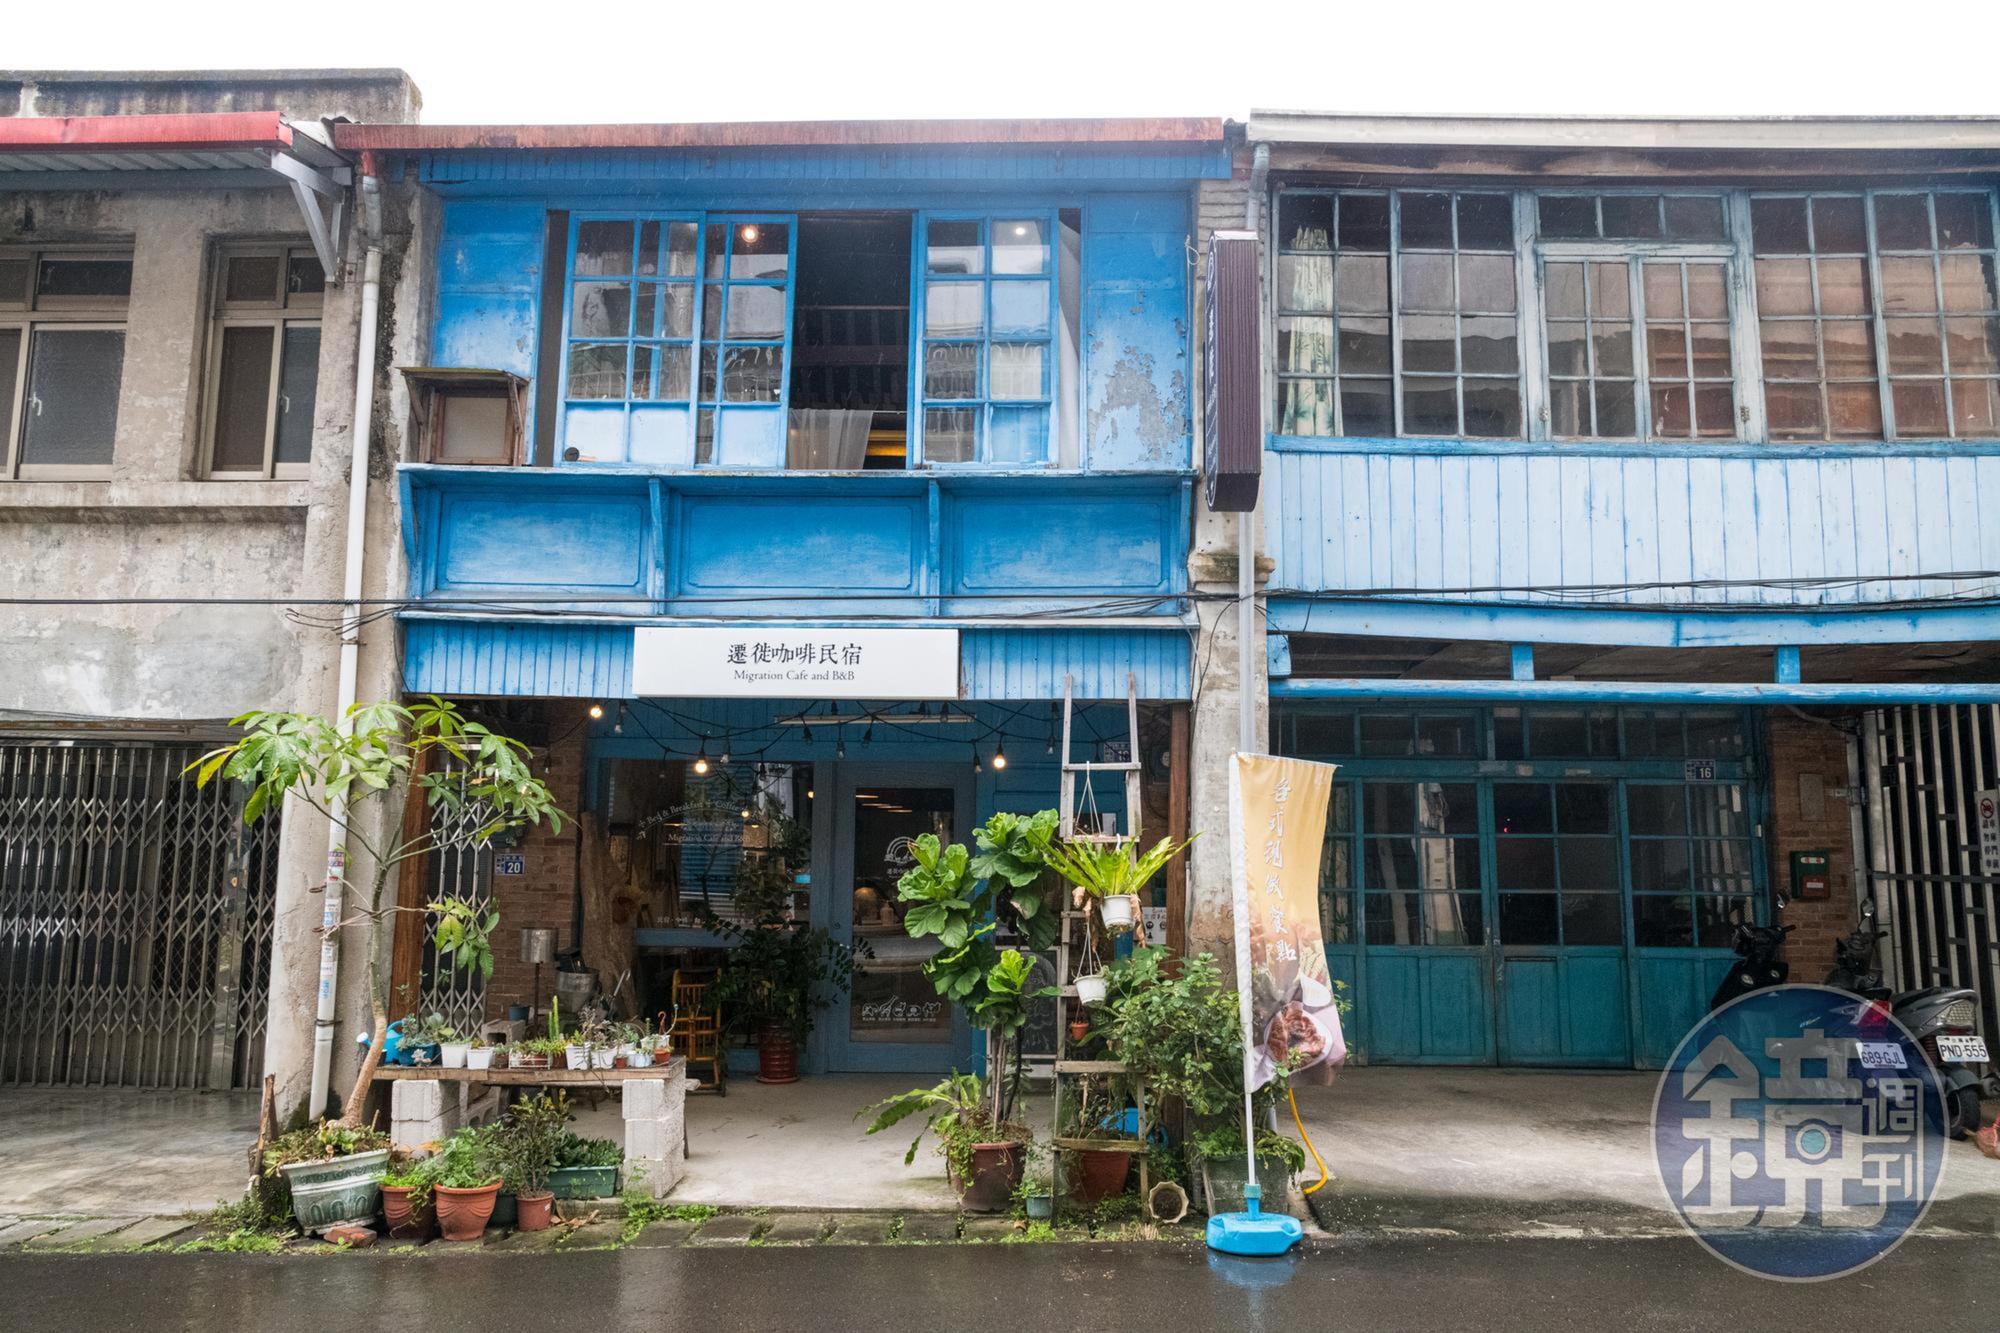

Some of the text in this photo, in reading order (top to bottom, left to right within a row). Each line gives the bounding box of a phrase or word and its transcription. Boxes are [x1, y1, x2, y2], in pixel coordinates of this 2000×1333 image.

[727, 642, 863, 666] 遷徙咖啡民宿
[734, 669, 855, 683] Migration Cafe and B&B
[1700, 767, 1711, 778] 16
[507, 862, 520, 873] 20
[1861, 1051, 1905, 1065] 689-GJL
[1940, 1044, 1987, 1059] PND-555
